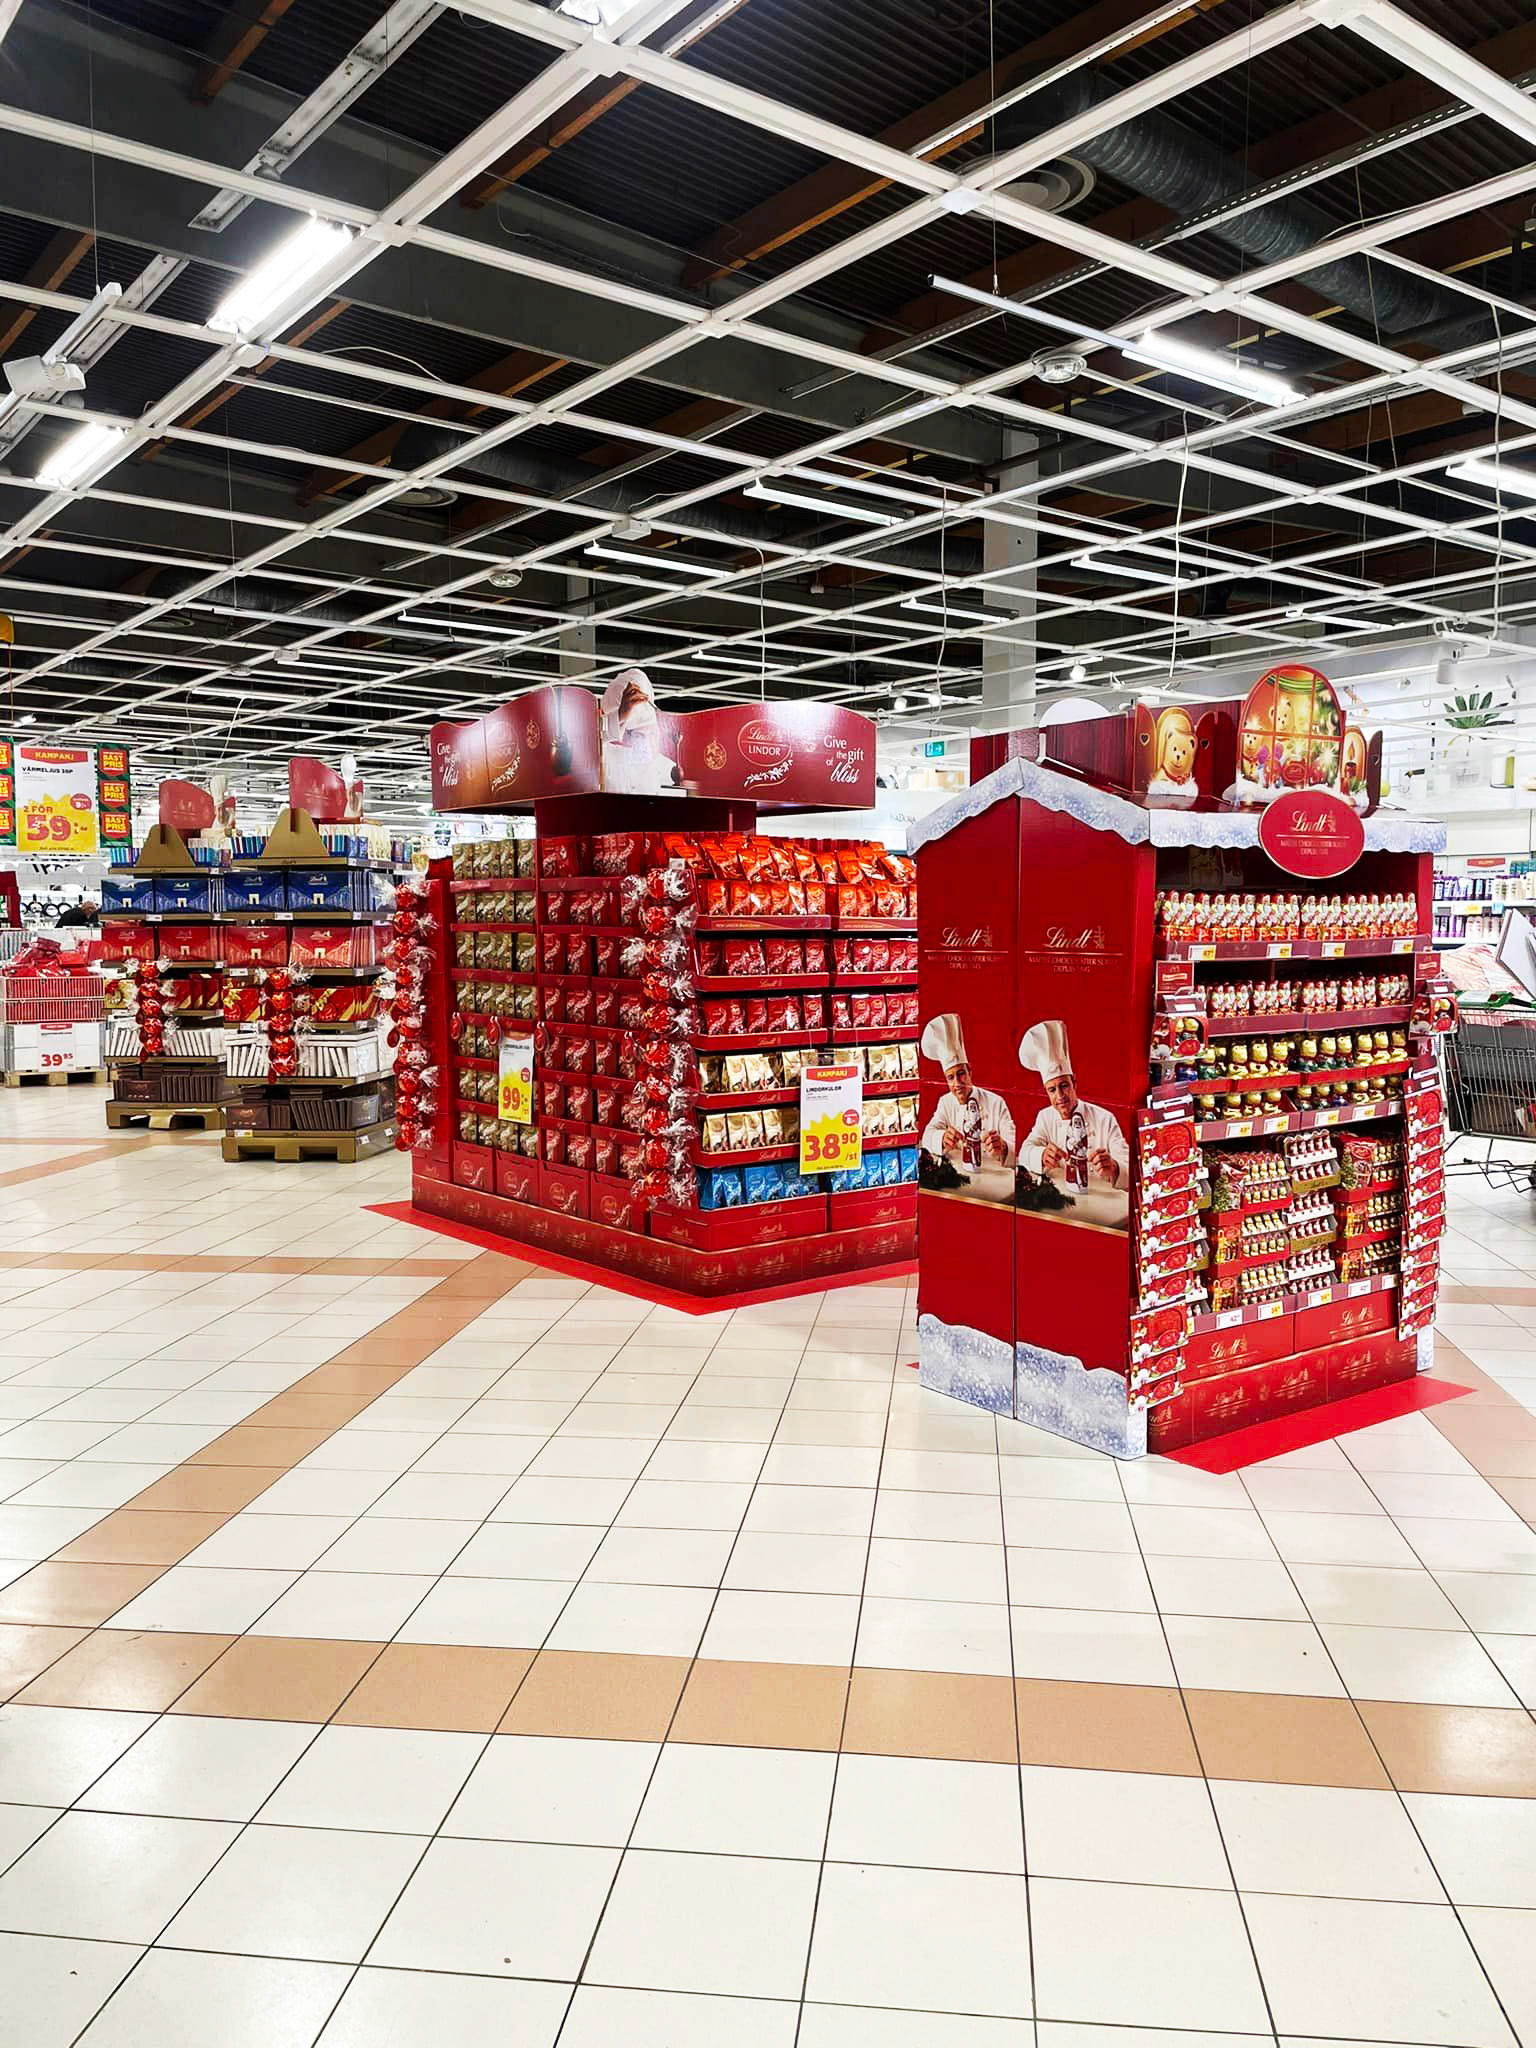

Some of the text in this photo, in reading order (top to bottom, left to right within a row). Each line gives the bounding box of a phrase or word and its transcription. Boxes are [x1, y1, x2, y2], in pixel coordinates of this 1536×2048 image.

[823, 734, 847, 749] Give
[35, 751, 74, 761] KAMPANJ
[748, 744, 781, 756] LINDOR
[104, 760, 124, 768] PRIS
[825, 757, 834, 767] of
[837, 747, 865, 769] the gift
[830, 761, 860, 784] bliss
[105, 791, 125, 799] PRIS
[107, 822, 127, 830] PRIS
[1289, 811, 1327, 832] Lindt
[939, 928, 982, 947] Lindt
[1042, 927, 1093, 949] Lindt
[41, 1053, 63, 1067] 39
[817, 1069, 848, 1078] KAMPANJ
[804, 1132, 857, 1162] 38 90
